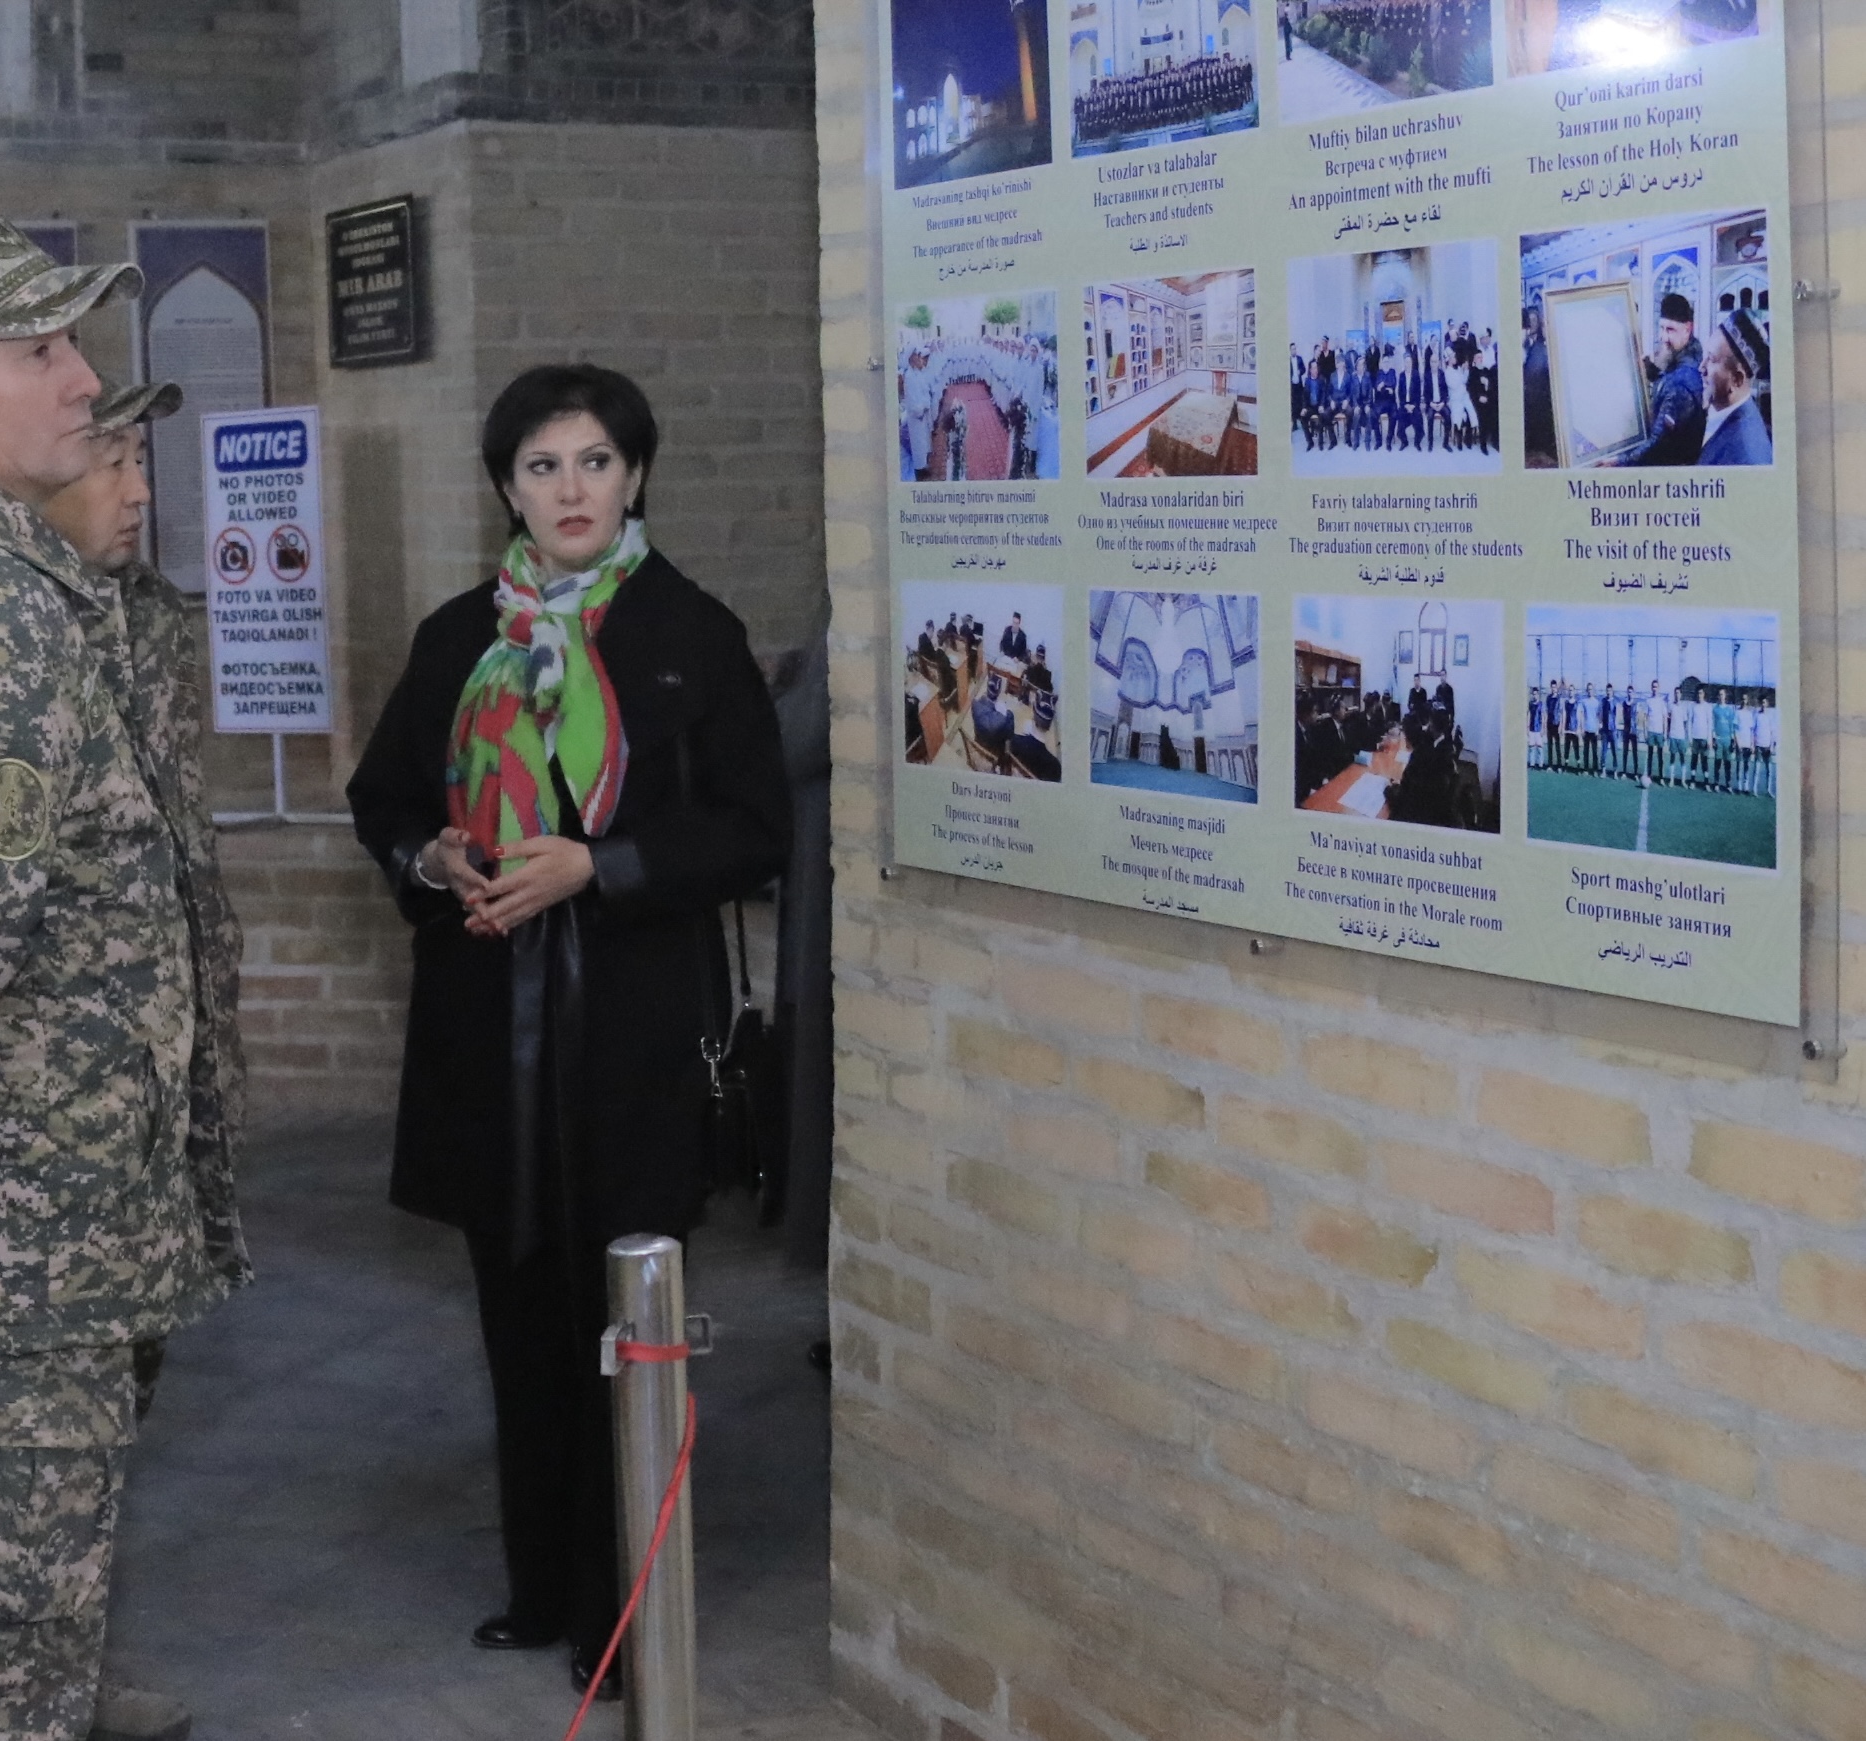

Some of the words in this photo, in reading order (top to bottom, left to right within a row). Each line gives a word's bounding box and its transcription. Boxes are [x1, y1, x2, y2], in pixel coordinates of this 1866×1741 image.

[1615, 74, 1660, 99] karim
[1664, 67, 1702, 91] darsi
[1309, 129, 1350, 149] Muftiy
[1356, 125, 1387, 143] bilan
[1393, 113, 1461, 137] uchrashuv
[1558, 118, 1618, 138] Занятии
[1624, 115, 1641, 128] по
[1647, 106, 1701, 127] Корану
[1326, 159, 1374, 178] Встреча
[1379, 157, 1384, 168] с
[1389, 148, 1446, 170] муфтием
[1527, 156, 1553, 174] The
[1558, 153, 1598, 170] lesson
[1604, 146, 1618, 163] of
[1622, 144, 1644, 161] the
[1650, 139, 1682, 159] Holy
[1691, 134, 1738, 152] Koran
[1099, 162, 1144, 183] Ustozlar
[1148, 162, 1160, 174] va
[1165, 150, 1217, 172] talabalar
[1094, 188, 1158, 207] Наставники
[1162, 186, 1168, 197] и
[1172, 178, 1223, 198] студенты
[1290, 195, 1305, 209] An
[1310, 182, 1390, 211] appointment
[1395, 176, 1423, 194] with
[1428, 173, 1448, 191] the
[1454, 166, 1491, 188] mufti
[1104, 211, 1146, 228] Teachers
[1150, 206, 1168, 222] and
[1171, 202, 1213, 219] students
[367, 269, 403, 294] ARAB
[219, 430, 301, 463] NOTICE
[219, 477, 239, 489] NO
[245, 472, 304, 488] PHOTOS
[1568, 480, 1660, 499] Mehmonlar
[1666, 479, 1724, 498] tashrifi
[227, 493, 247, 505] OR
[252, 490, 297, 504] VIDEO
[911, 490, 965, 505] Talabalarning
[967, 489, 994, 503] bitiruv
[997, 489, 1035, 503] marosimi
[1100, 492, 1147, 507] Madrasa
[1152, 491, 1218, 507] xonalaridan
[1223, 490, 1243, 507] biri
[1312, 494, 1346, 513] Faxriy
[1352, 494, 1431, 513] talabalarning
[1435, 493, 1477, 508] tashrifi
[228, 506, 297, 522] ALLOWED
[900, 510, 946, 523] Выпускные
[949, 513, 1004, 527] мероприятия
[1006, 514, 1049, 524] студентов
[1078, 515, 1103, 529] Одно
[1107, 519, 1117, 529] из
[1120, 515, 1164, 532] учебных
[1233, 519, 1277, 534] медресе
[1591, 507, 1637, 526] Визит
[1646, 508, 1700, 527] гостей
[1318, 518, 1350, 532] Визит
[1354, 522, 1410, 532] почетных
[1414, 522, 1472, 537] студентов
[900, 531, 915, 544] The
[916, 532, 959, 547] graduation
[960, 535, 998, 549] ceremony
[1002, 532, 1013, 545] of
[1012, 532, 1025, 546] the
[1027, 532, 1062, 546] students
[1096, 535, 1115, 550] One
[1117, 536, 1127, 550] of
[1129, 536, 1143, 550] the
[1146, 540, 1174, 551] rooms
[1177, 537, 1187, 551] of
[1189, 537, 1204, 551] the
[1207, 537, 1255, 552] madrasah
[1289, 538, 1309, 553] The
[1312, 538, 1371, 558] graduation
[1376, 543, 1429, 559] ceremony
[1435, 539, 1447, 555] of
[1450, 539, 1468, 555] the
[1472, 540, 1522, 556] students
[1564, 539, 1592, 559] The
[1597, 539, 1628, 559] visit
[1633, 540, 1649, 559] of
[1653, 540, 1676, 560] the
[1682, 544, 1730, 566] guests
[218, 591, 250, 603] FOTO
[256, 590, 272, 603] VA
[277, 589, 316, 602] VIDEO
[214, 610, 278, 623] TASVIRGA
[283, 608, 322, 622] OLISH
[221, 628, 308, 642] TAQIQLANADI
[222, 662, 320, 676] ФОТОСЪЕМКА,
[221, 682, 323, 696] ВИДЕОСЪЕМКА
[235, 701, 316, 717] ЗАПРЕЩЕНА
[1120, 805, 1184, 832] Madrasaning
[1188, 818, 1225, 835] masjidi
[1131, 835, 1168, 854] Мечеть
[1172, 845, 1212, 861] медресе
[1382, 846, 1435, 863] xonasida
[1440, 851, 1482, 870] suhbat
[1102, 855, 1119, 872] The
[1122, 863, 1159, 880] mosque
[1162, 866, 1172, 880] of
[1175, 868, 1190, 884] the
[1194, 874, 1244, 892] madrasah
[1297, 857, 1336, 877] Беседе
[1341, 867, 1347, 878] в
[1352, 869, 1403, 887] комнате
[1408, 878, 1496, 901] просвещения
[1572, 867, 1610, 890] Sport
[1285, 882, 1305, 898] The
[1309, 890, 1380, 911] conversation
[1385, 898, 1394, 913] in
[1400, 900, 1417, 917] the
[1422, 904, 1465, 925] Morale
[1470, 916, 1502, 931] room
[1566, 896, 1662, 927] Спортивные
[1668, 916, 1731, 937] занятия
